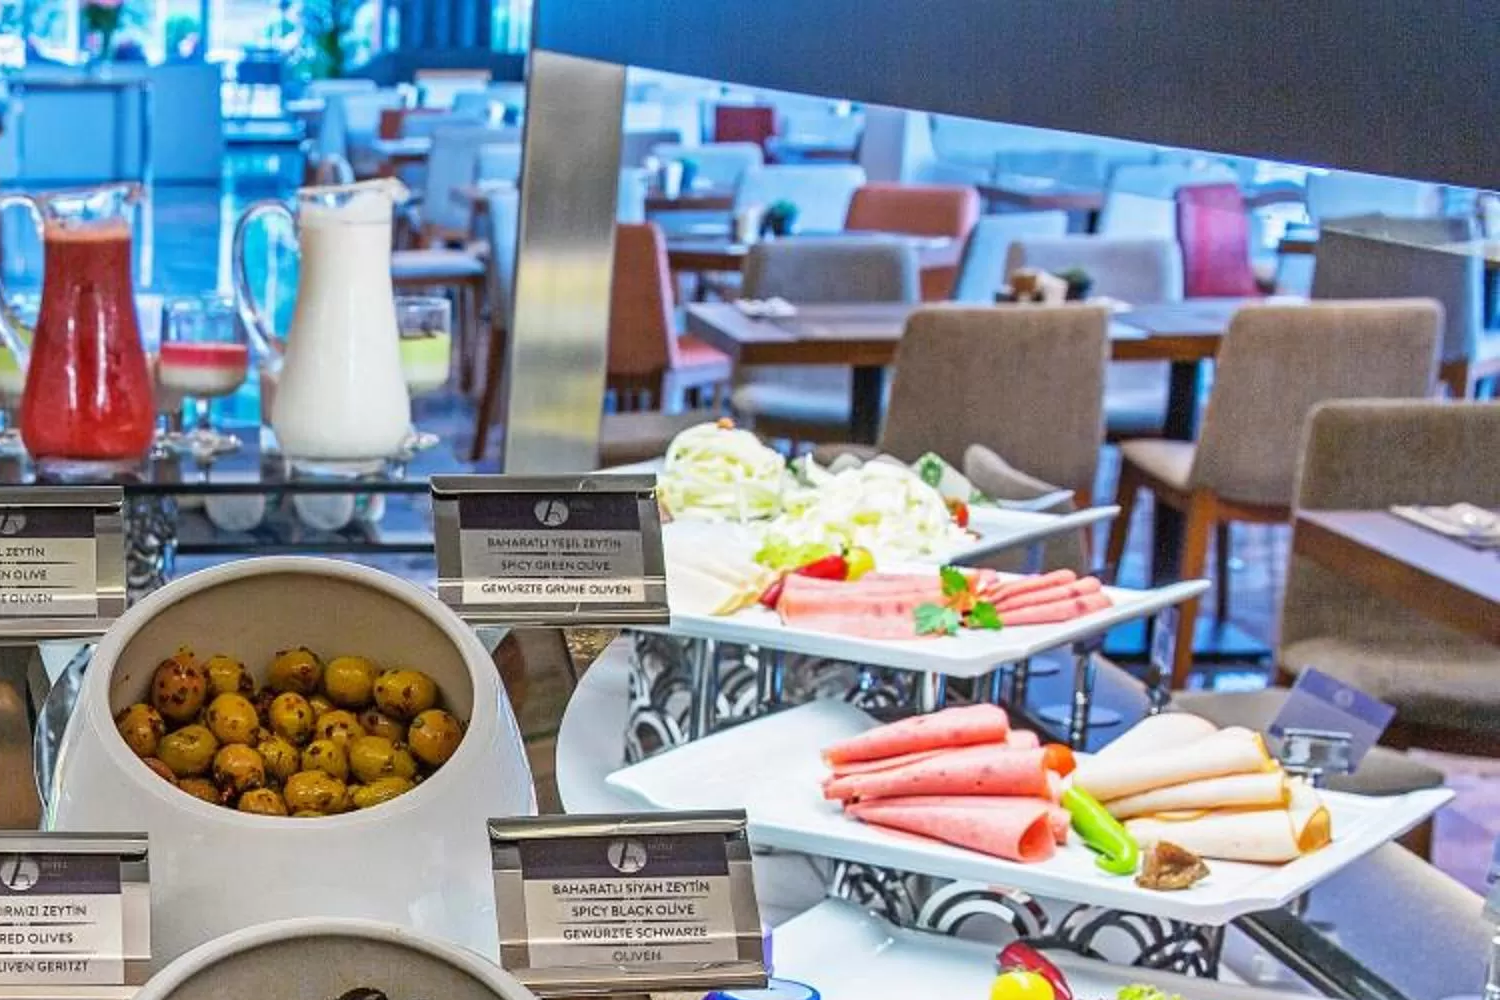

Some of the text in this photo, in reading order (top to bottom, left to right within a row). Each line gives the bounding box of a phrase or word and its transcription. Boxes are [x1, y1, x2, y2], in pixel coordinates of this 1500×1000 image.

[5, 545, 45, 557] ZEYTİN
[501, 560, 532, 571] SPICY
[535, 560, 575, 571] GREEN
[13, 569, 47, 580] OLIVE
[589, 583, 631, 595] OLIVEN
[9, 593, 53, 604] OLIVEN
[552, 882, 623, 895] BAHARATLI
[666, 879, 710, 893] ZEYTİN
[571, 905, 608, 917] SPICY
[611, 905, 653, 917] BLACK
[0, 933, 25, 945] RED
[27, 932, 74, 944] OLIVES
[636, 927, 707, 938] SCHWARZE
[612, 950, 663, 962] OLIVEN
[37, 960, 88, 972] GERITZT
